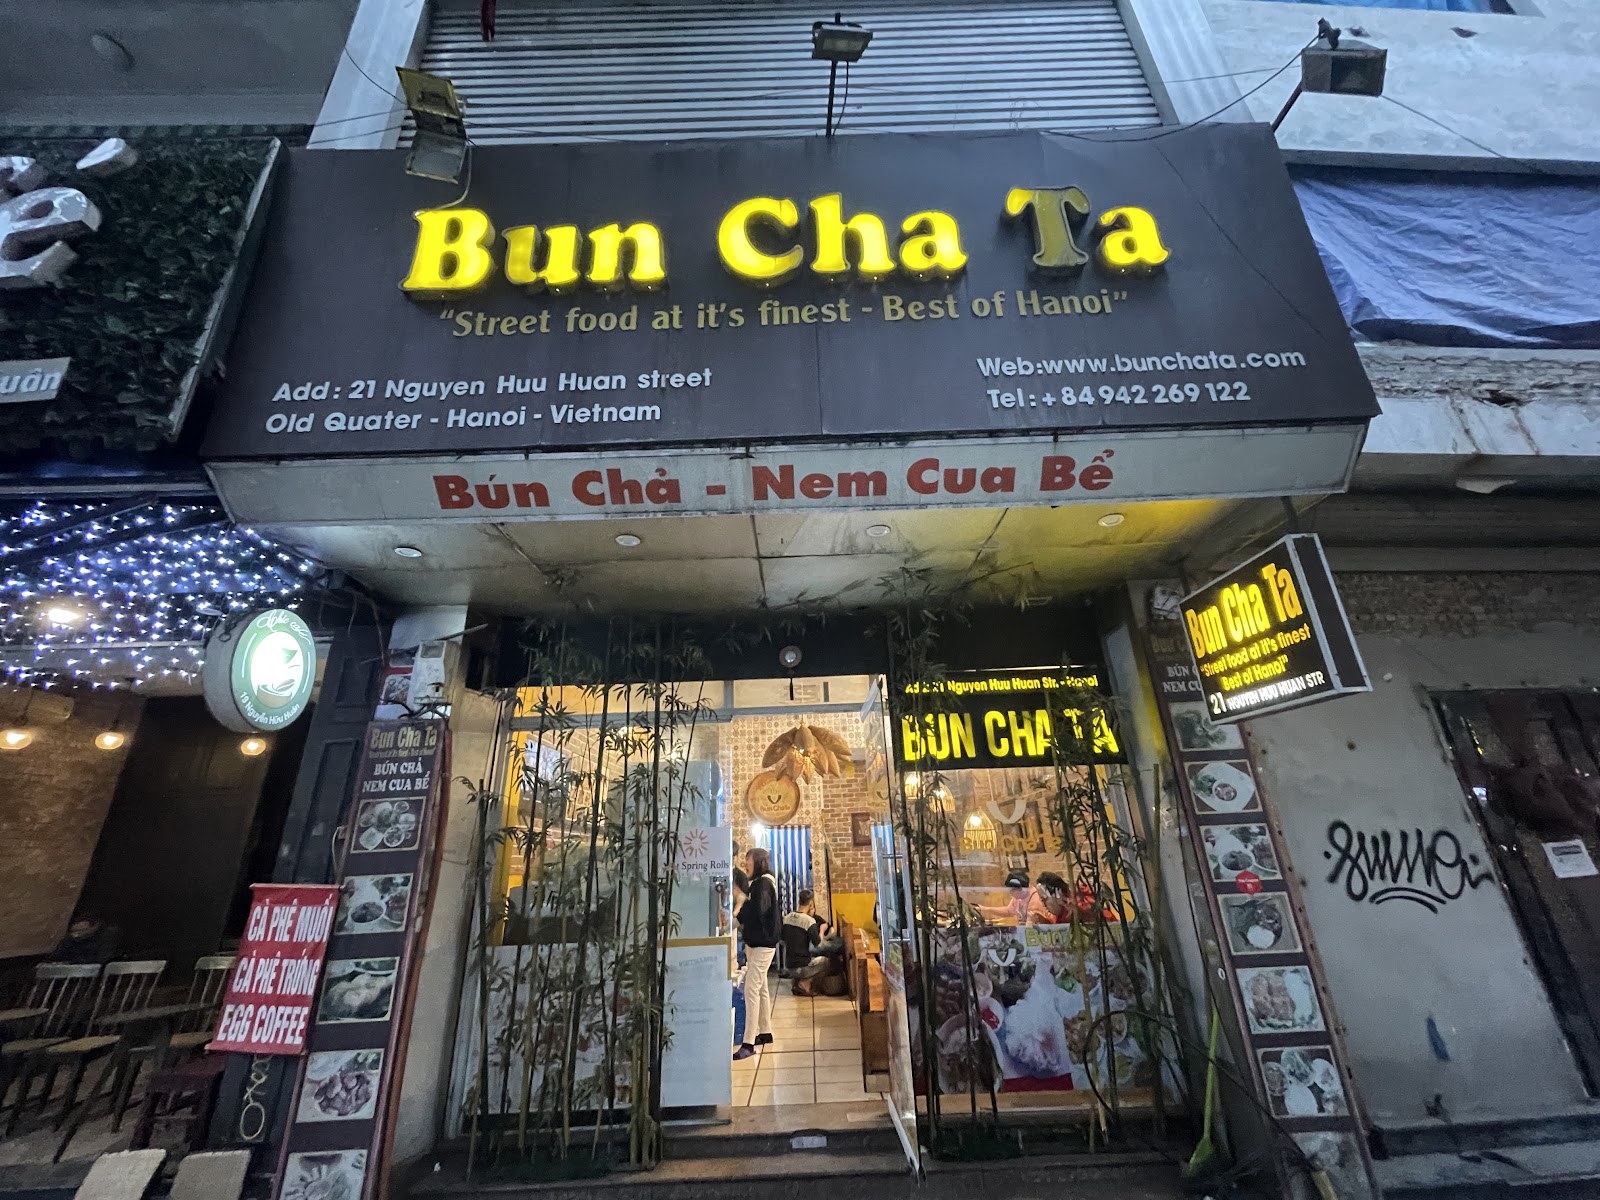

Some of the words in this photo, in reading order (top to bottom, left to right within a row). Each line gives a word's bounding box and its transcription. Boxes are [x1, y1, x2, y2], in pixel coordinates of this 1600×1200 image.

[400, 208, 666, 291] Bun
[718, 192, 968, 279] Cha
[1005, 185, 1171, 267] Ta
[566, 306, 638, 332] food
[651, 305, 683, 330] at
[758, 300, 851, 326] finest
[883, 295, 960, 321] Best
[972, 291, 1005, 317] of
[348, 380, 375, 399] 21
[385, 377, 485, 403] Nguyen
[497, 374, 547, 394] Huu
[558, 372, 626, 391] Huan
[637, 368, 712, 389] street
[1099, 385, 1149, 404] 942
[1153, 383, 1200, 404] 269
[1204, 381, 1251, 402] 122
[266, 413, 315, 433] Old
[324, 411, 422, 432] Quater
[447, 406, 526, 428] Hanoi
[550, 402, 661, 424] Vietnam
[432, 474, 551, 510] Bún
[572, 467, 681, 506] Chả
[752, 464, 888, 500] Nem
[906, 457, 1017, 494] Cua
[1040, 449, 1115, 492] Bể
[1185, 604, 1228, 659] Bun
[1219, 582, 1270, 643] Cha
[1261, 563, 1303, 623] Ta
[1226, 647, 1250, 668] food
[1249, 642, 1261, 660] at
[1278, 623, 1311, 649] finest
[947, 679, 988, 695] Nguyen
[989, 677, 1010, 690] Huu
[1012, 676, 1041, 690] Huan
[1162, 681, 1187, 692] NEM
[1188, 681, 1202, 691] CU
[1210, 692, 1227, 714] 21
[1259, 683, 1279, 701] HUU
[1278, 676, 1306, 696] HUAN
[1305, 670, 1326, 688] STR
[1221, 671, 1243, 691] Best
[1243, 667, 1254, 685] of
[370, 728, 395, 748] Bun
[398, 726, 421, 747] Cha
[425, 725, 438, 746] Ta
[901, 711, 976, 761] BUN
[984, 709, 1060, 757] CHA
[374, 760, 398, 775] BÚN
[400, 757, 422, 774] CHẢ
[362, 780, 387, 792] NEM
[389, 778, 412, 791] CUA
[681, 860, 708, 872] Spring
[710, 860, 729, 869] Rolls
[267, 898, 298, 942] PHÊ
[293, 894, 334, 943] MUỐI
[252, 951, 281, 994] PHÊ
[217, 1004, 255, 1042] EGG
[251, 1005, 309, 1044] COFFEE
